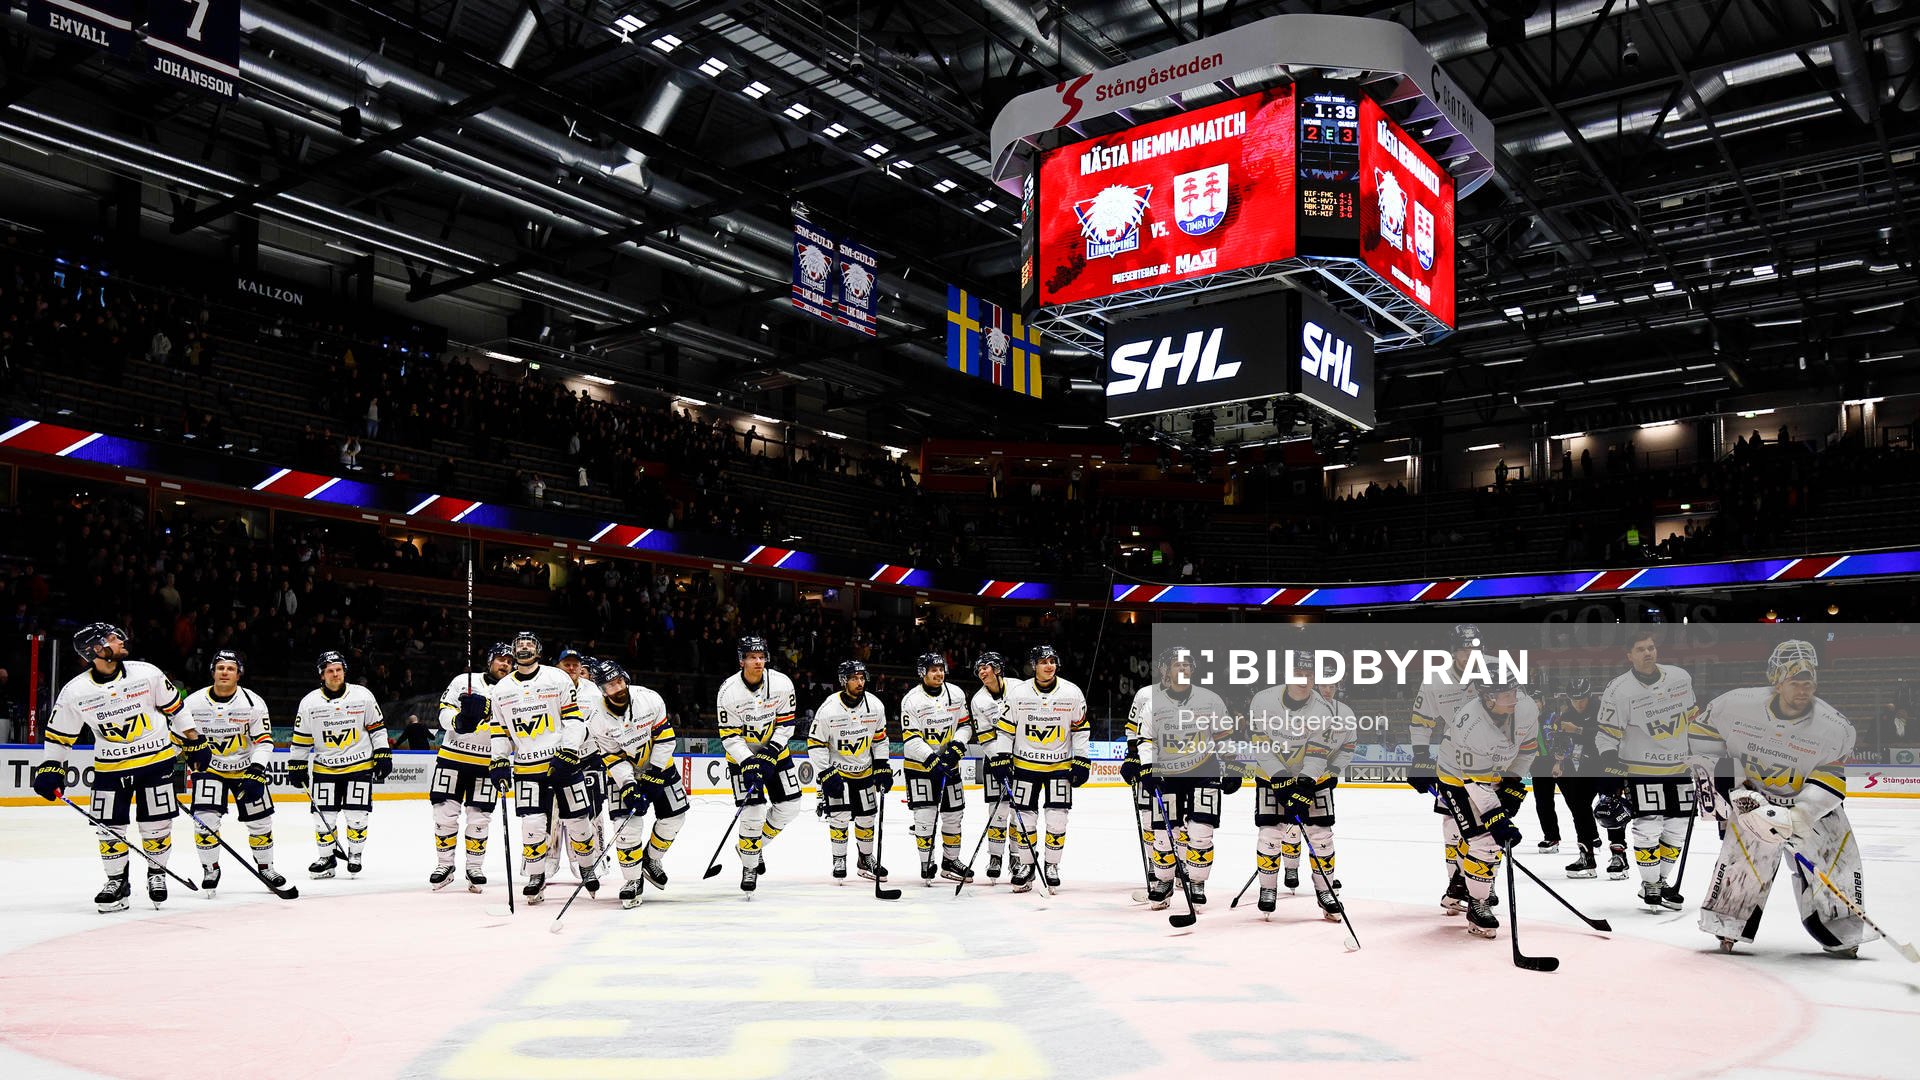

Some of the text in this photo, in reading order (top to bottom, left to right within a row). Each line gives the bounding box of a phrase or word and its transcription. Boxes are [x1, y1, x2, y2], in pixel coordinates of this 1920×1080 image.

[50, 12, 109, 47] EMVALL
[154, 57, 233, 97] JOHANSSON
[1096, 53, 1223, 102] Stångåstaden
[1315, 104, 1356, 119] 1:39
[1307, 127, 1318, 140] 2
[1343, 129, 1353, 142] 3
[1080, 111, 1246, 176] NÄSTA HEMMAMATCH
[1112, 268, 1159, 285] PRESENTERAS
[238, 278, 303, 305] KALLZON
[1106, 327, 1242, 397] SHL
[1301, 321, 1360, 398] SHL
[570, 690, 577, 702] 2
[105, 702, 141, 718] Husqvarna
[517, 704, 547, 714] Husqvarna
[719, 710, 728, 724] 8
[1652, 702, 1683, 716] Husqvarna
[98, 713, 147, 741] HV71
[262, 718, 270, 731] 5
[512, 713, 549, 736] HV71
[902, 715, 910, 726] 6
[1025, 724, 1061, 744] HV71
[102, 738, 166, 757] FAGERHULT
[450, 739, 491, 753] FAGERHU
[1756, 745, 1798, 763] Husqvarna
[211, 757, 251, 770] GERHULT
[1853, 871, 1862, 906] BAUER
